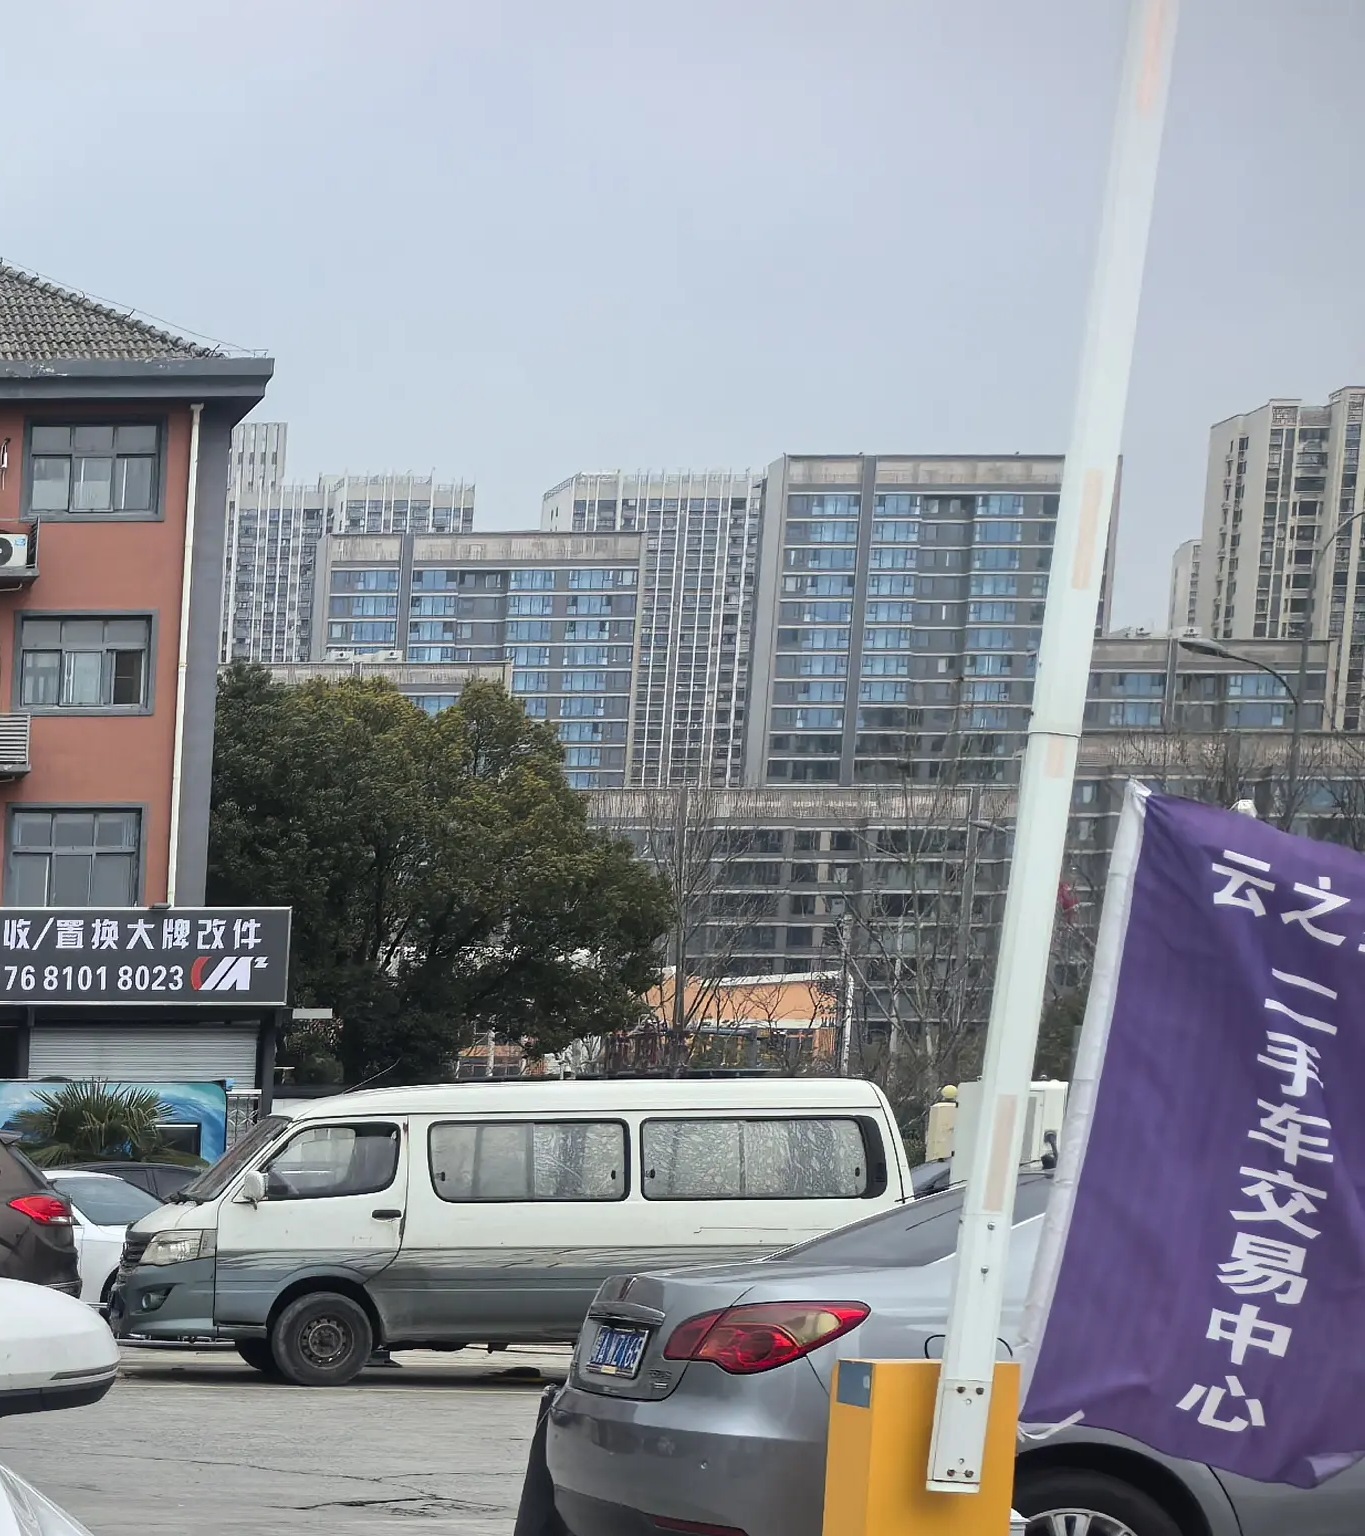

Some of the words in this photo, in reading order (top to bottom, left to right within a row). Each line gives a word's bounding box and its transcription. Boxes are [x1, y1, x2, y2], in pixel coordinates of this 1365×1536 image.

[1211, 848, 1365, 952] 云之
[43, 965, 107, 991] 8101
[117, 965, 184, 991] 8023
[1177, 967, 1337, 1432] 二手车交易中心
